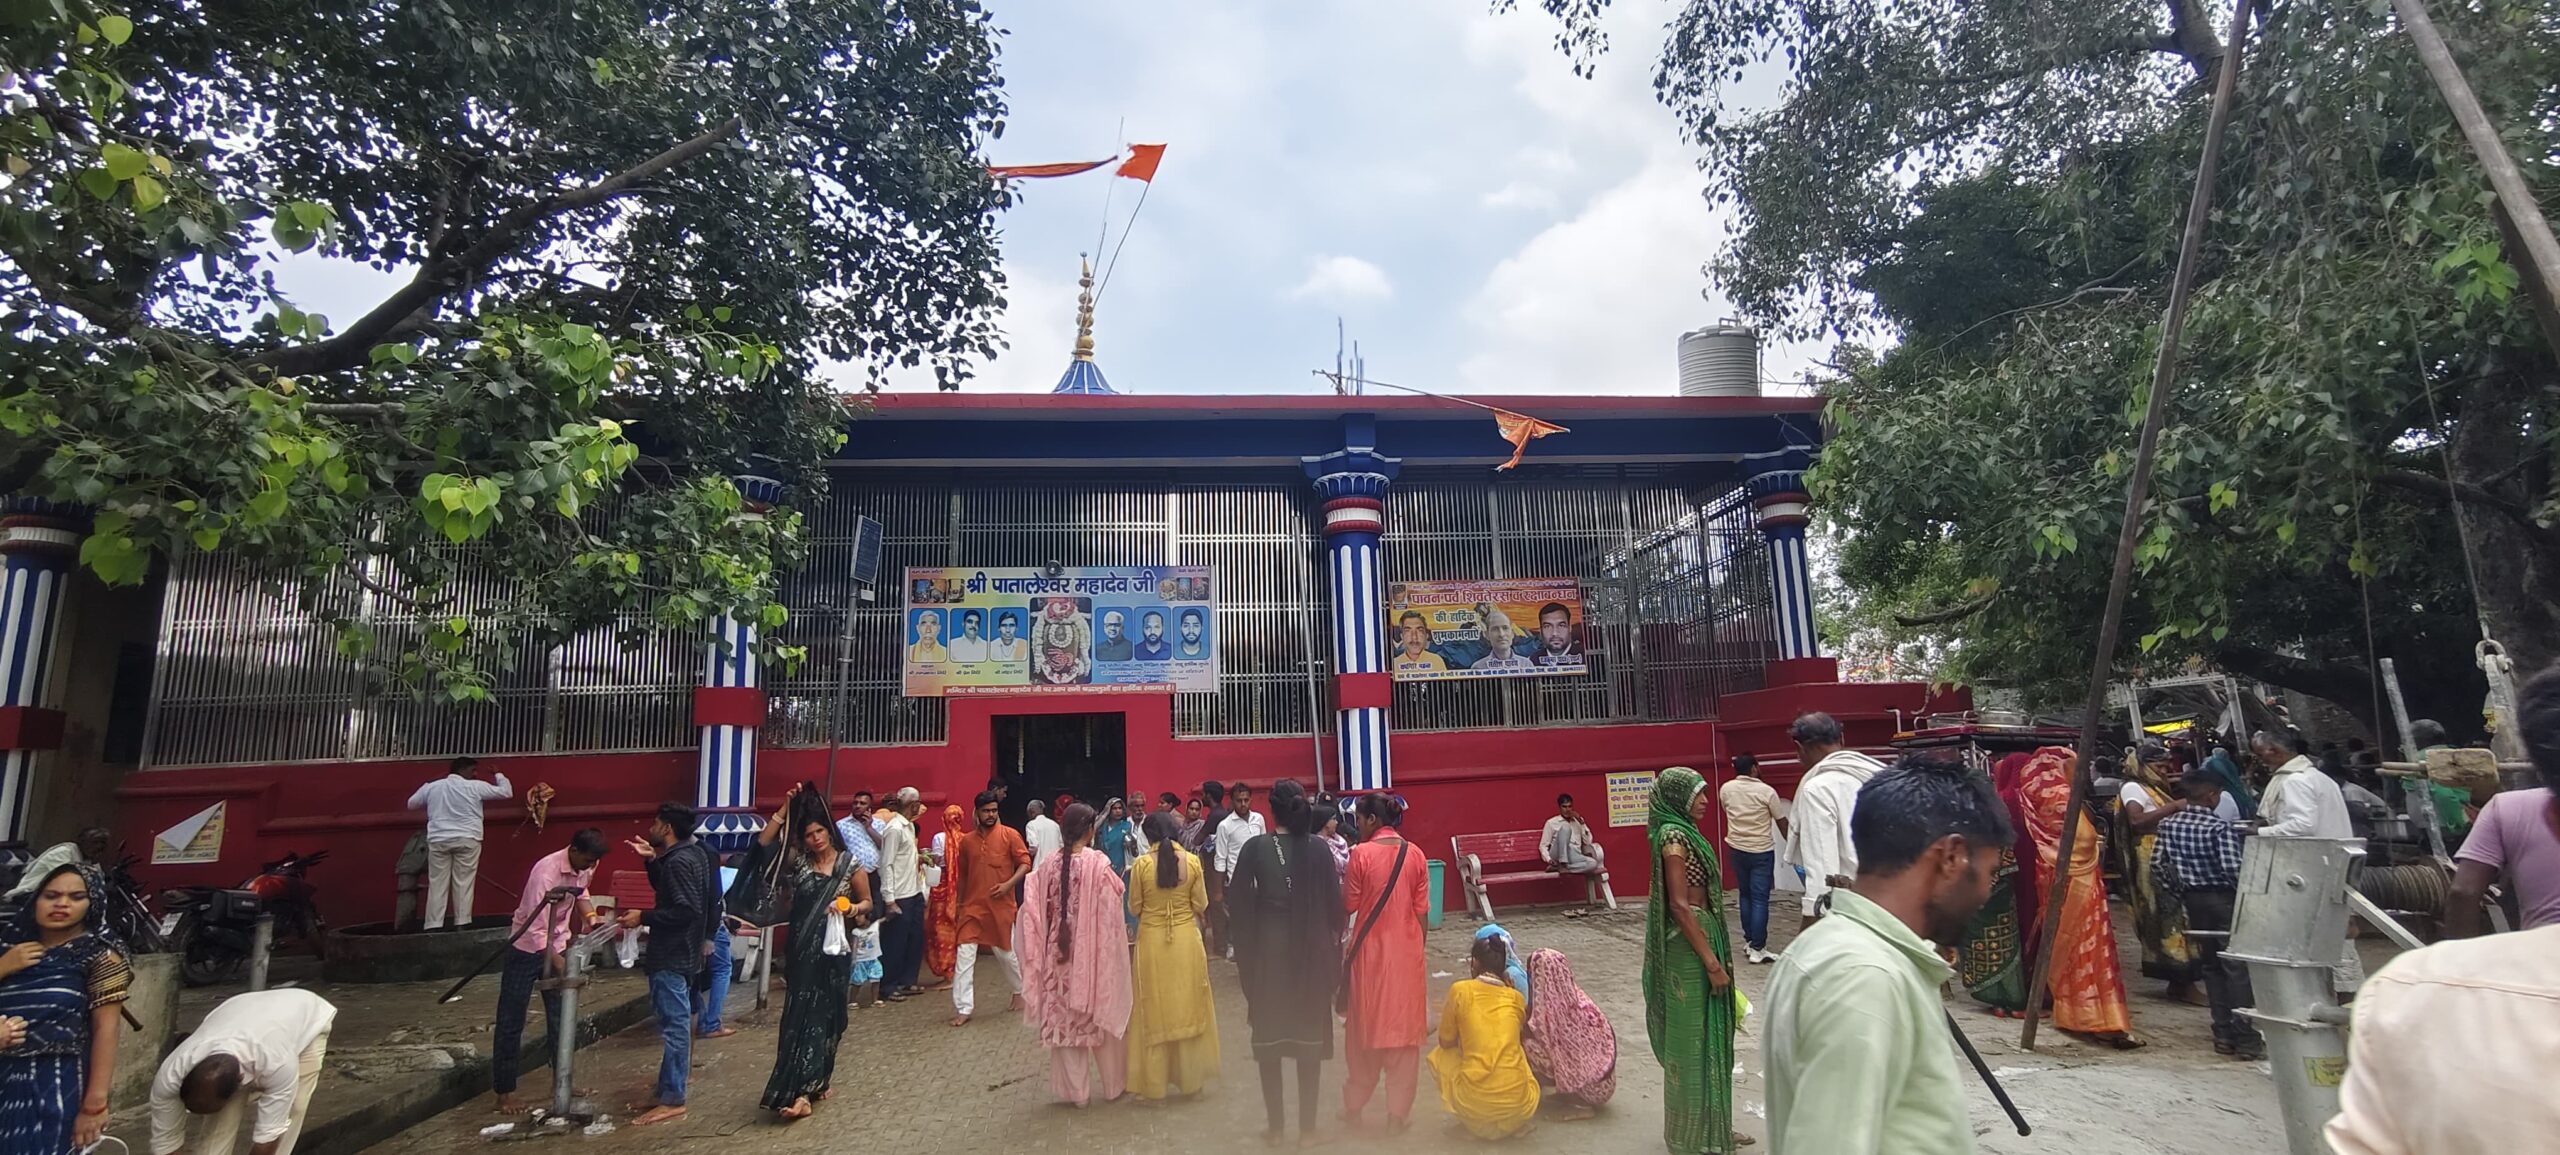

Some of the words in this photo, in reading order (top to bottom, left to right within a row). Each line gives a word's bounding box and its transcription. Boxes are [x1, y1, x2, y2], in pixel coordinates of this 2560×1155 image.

[966, 571, 987, 594] श्री
[992, 571, 1071, 595] पातालेश्वर
[1074, 571, 1129, 595] महादेव
[1131, 570, 1156, 593] जी
[1411, 593, 1441, 604] पावन
[1443, 590, 1459, 603] पर्व
[1434, 609, 1447, 623] की
[1449, 608, 1476, 622] हार्दिक
